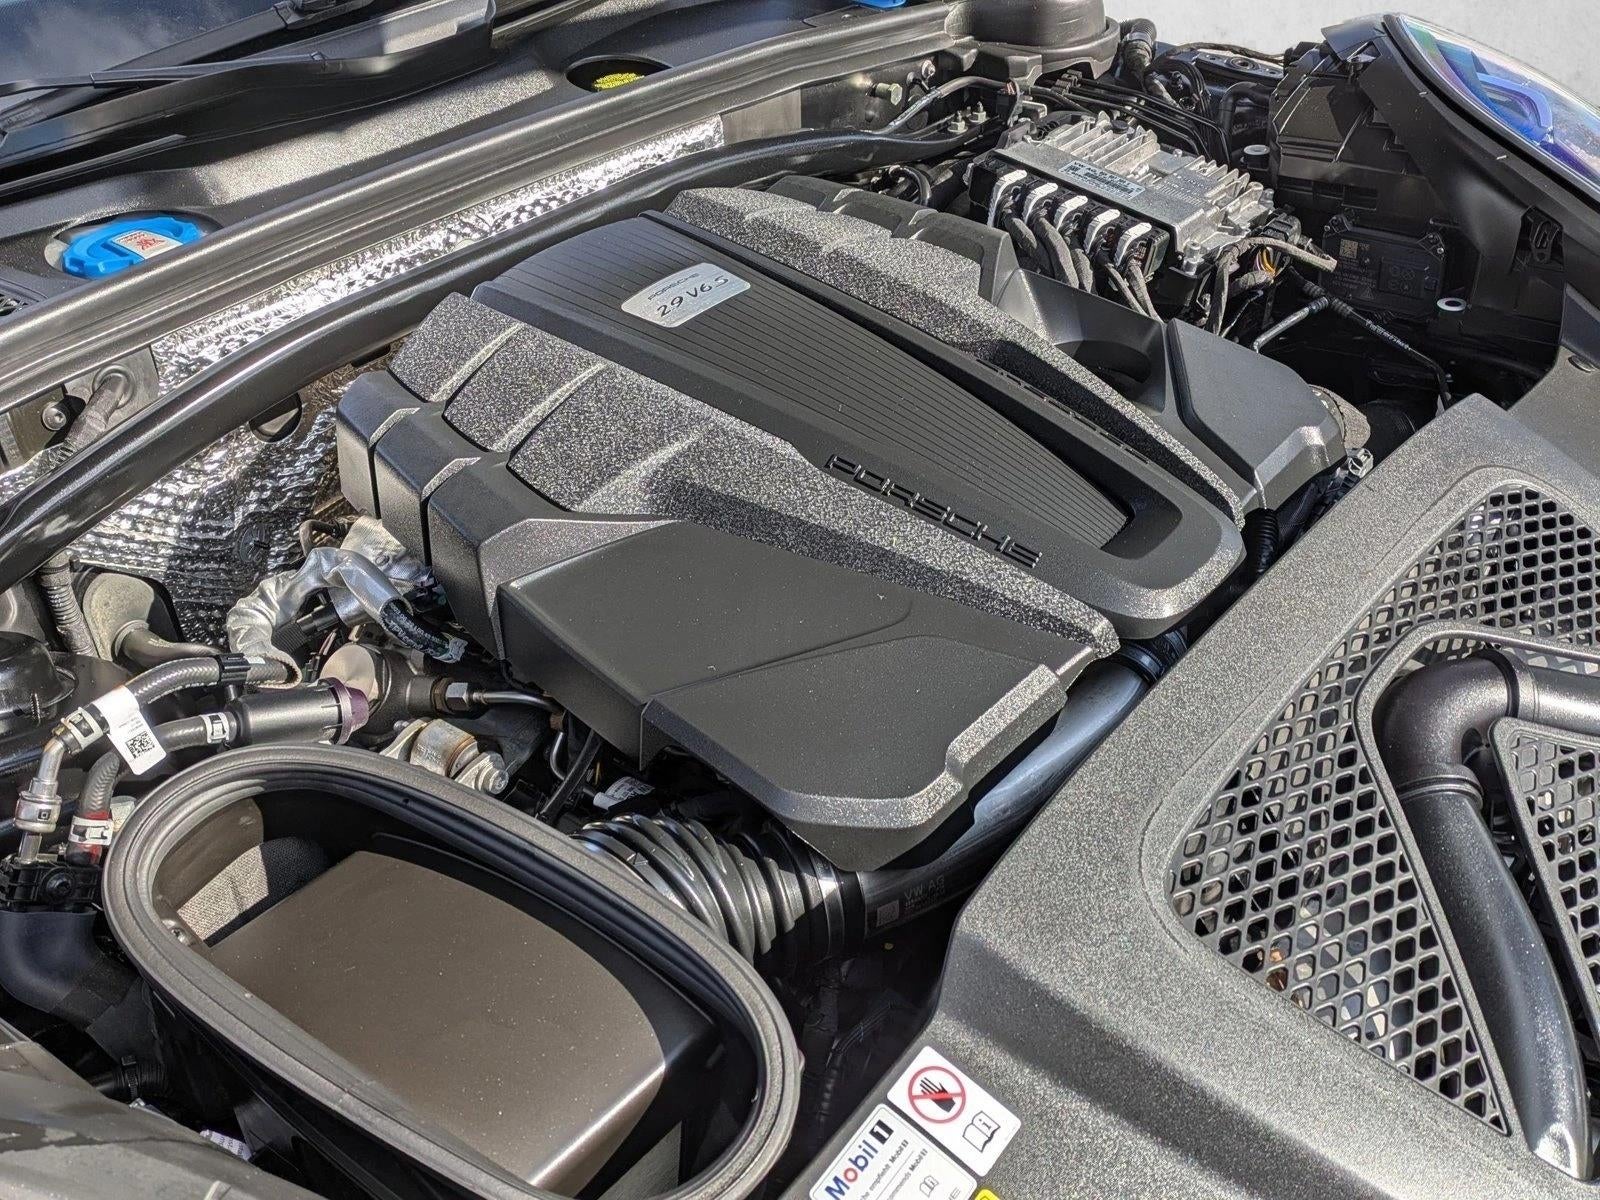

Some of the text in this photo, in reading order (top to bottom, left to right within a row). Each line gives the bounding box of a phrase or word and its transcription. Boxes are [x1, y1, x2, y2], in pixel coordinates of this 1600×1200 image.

[647, 272, 700, 301] PORSCHE
[686, 283, 713, 299] V6
[714, 275, 729, 288] S
[824, 453, 1042, 569] PORSCHE
[824, 1120, 893, 1200] Mobil 1
[889, 1145, 904, 1163] Mobil
[909, 1154, 924, 1172] Mobil
